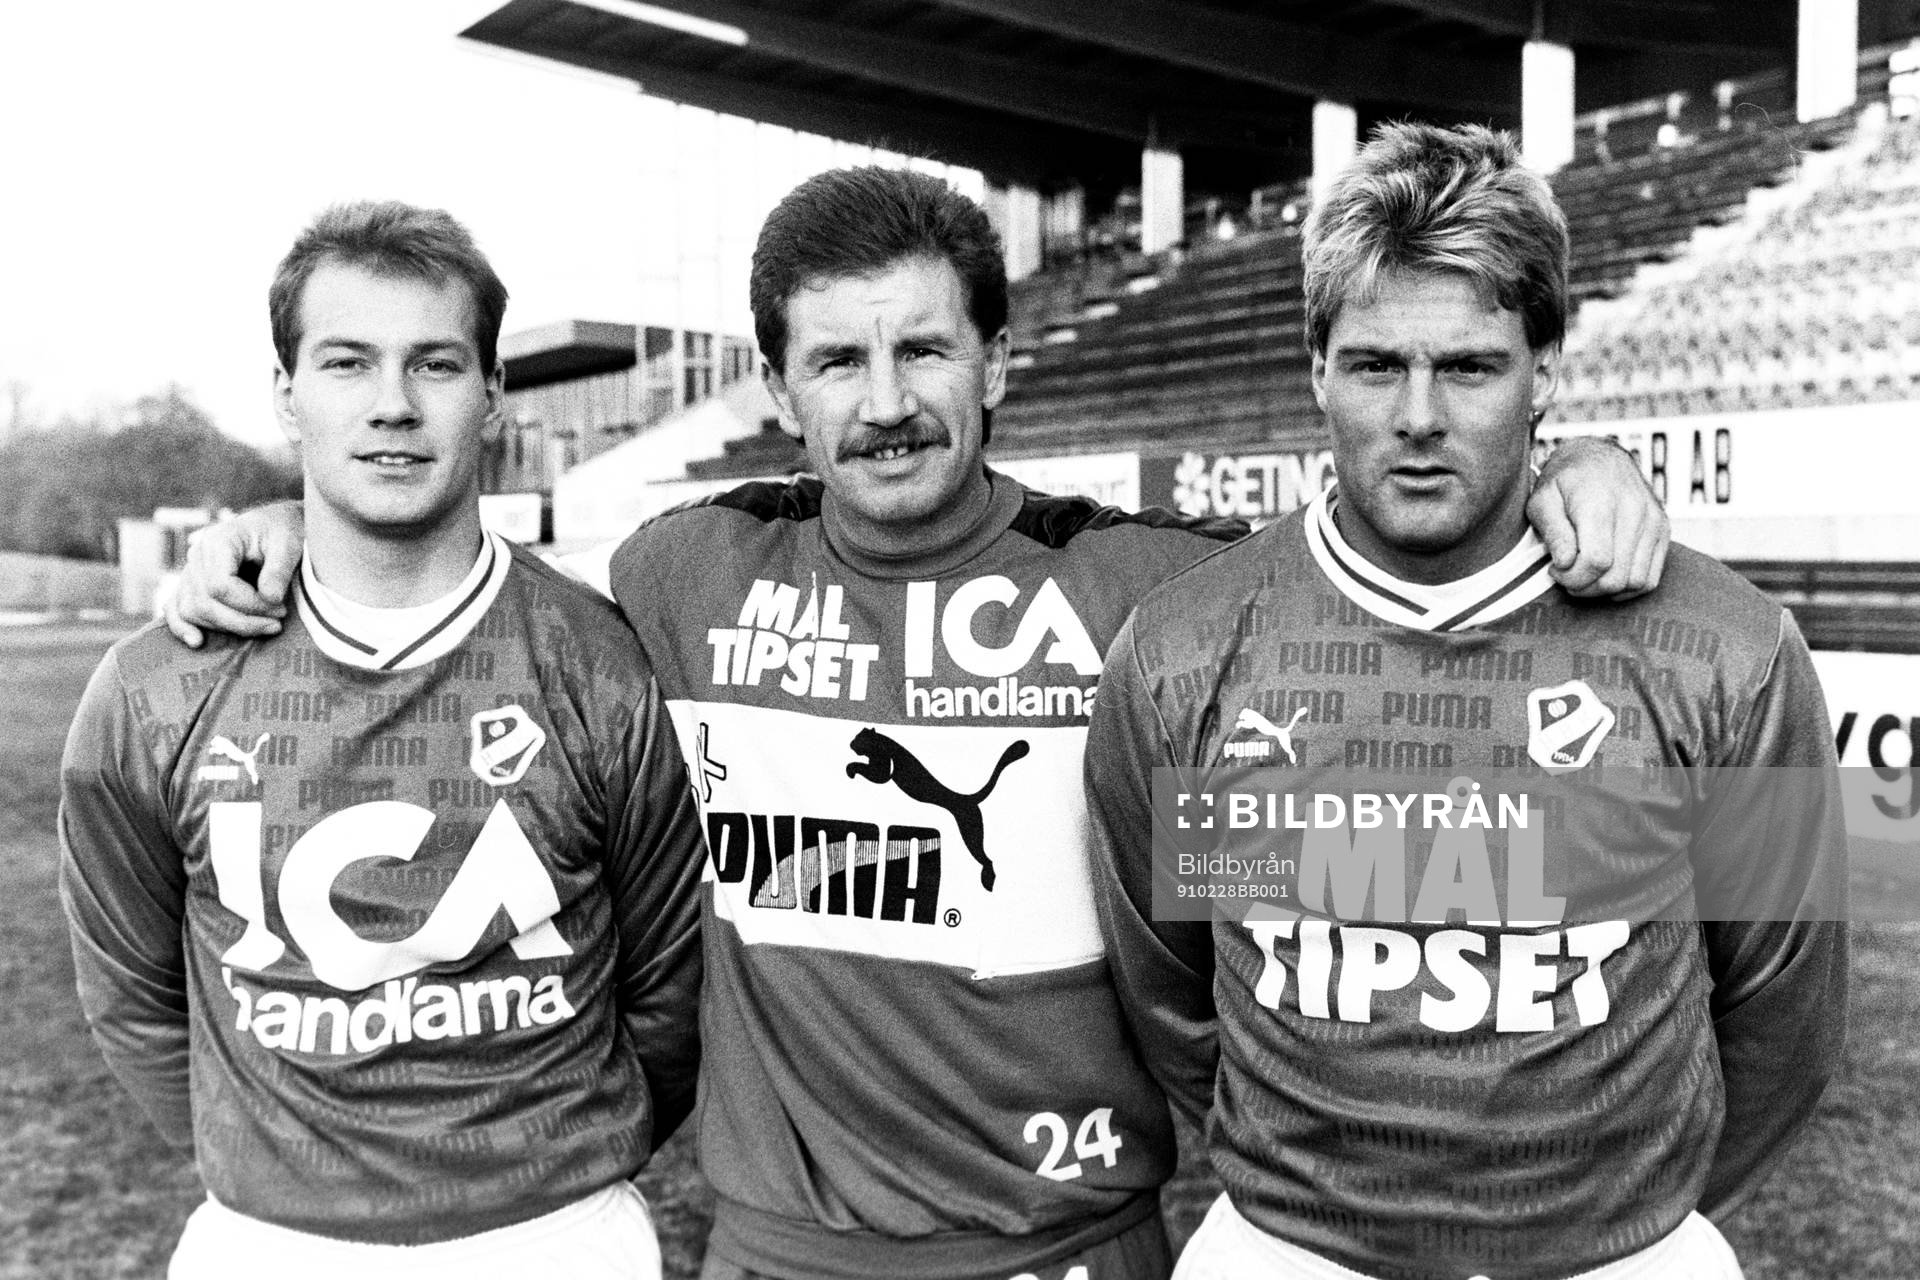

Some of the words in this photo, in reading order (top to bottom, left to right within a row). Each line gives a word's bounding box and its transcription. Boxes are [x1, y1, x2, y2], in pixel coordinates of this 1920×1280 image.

[1690, 428, 1730, 503] AB
[905, 575, 1104, 678] ICA
[1279, 641, 1382, 676] PUMA
[707, 628, 880, 701] TIPSET
[1421, 649, 1532, 682] PUMA
[242, 690, 332, 722] PUMA
[1382, 691, 1493, 730] PUMA
[1298, 776, 1567, 928] MÅL
[208, 797, 575, 992] ICA
[1241, 901, 1631, 1033] TIPSET
[1023, 1108, 1123, 1182] 24
